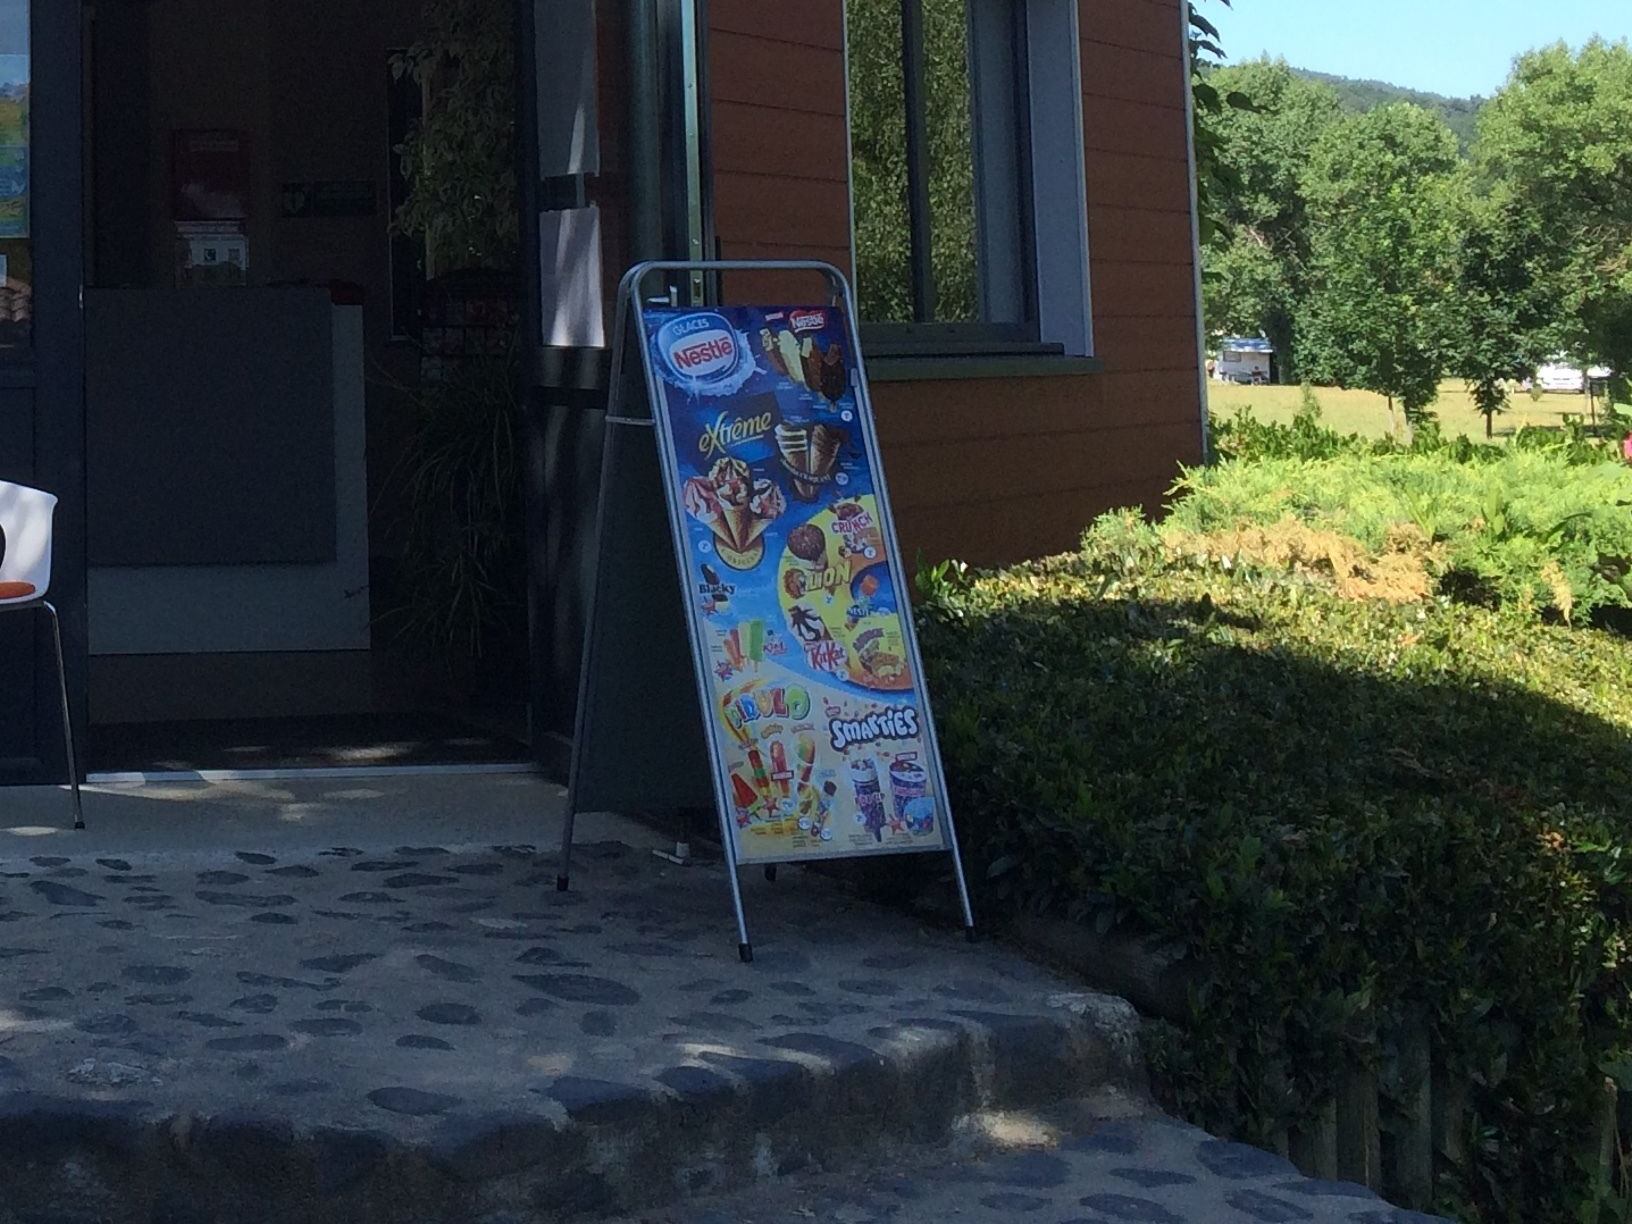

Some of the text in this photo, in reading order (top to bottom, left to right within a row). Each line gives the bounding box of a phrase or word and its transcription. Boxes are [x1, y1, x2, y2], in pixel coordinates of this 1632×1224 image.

[672, 318, 710, 335] GLACES
[673, 337, 733, 370] Nestlé
[831, 511, 872, 535] CRUNCH
[699, 583, 736, 596] Blacky
[806, 559, 851, 592] LION
[831, 707, 919, 751] SMARTIES
